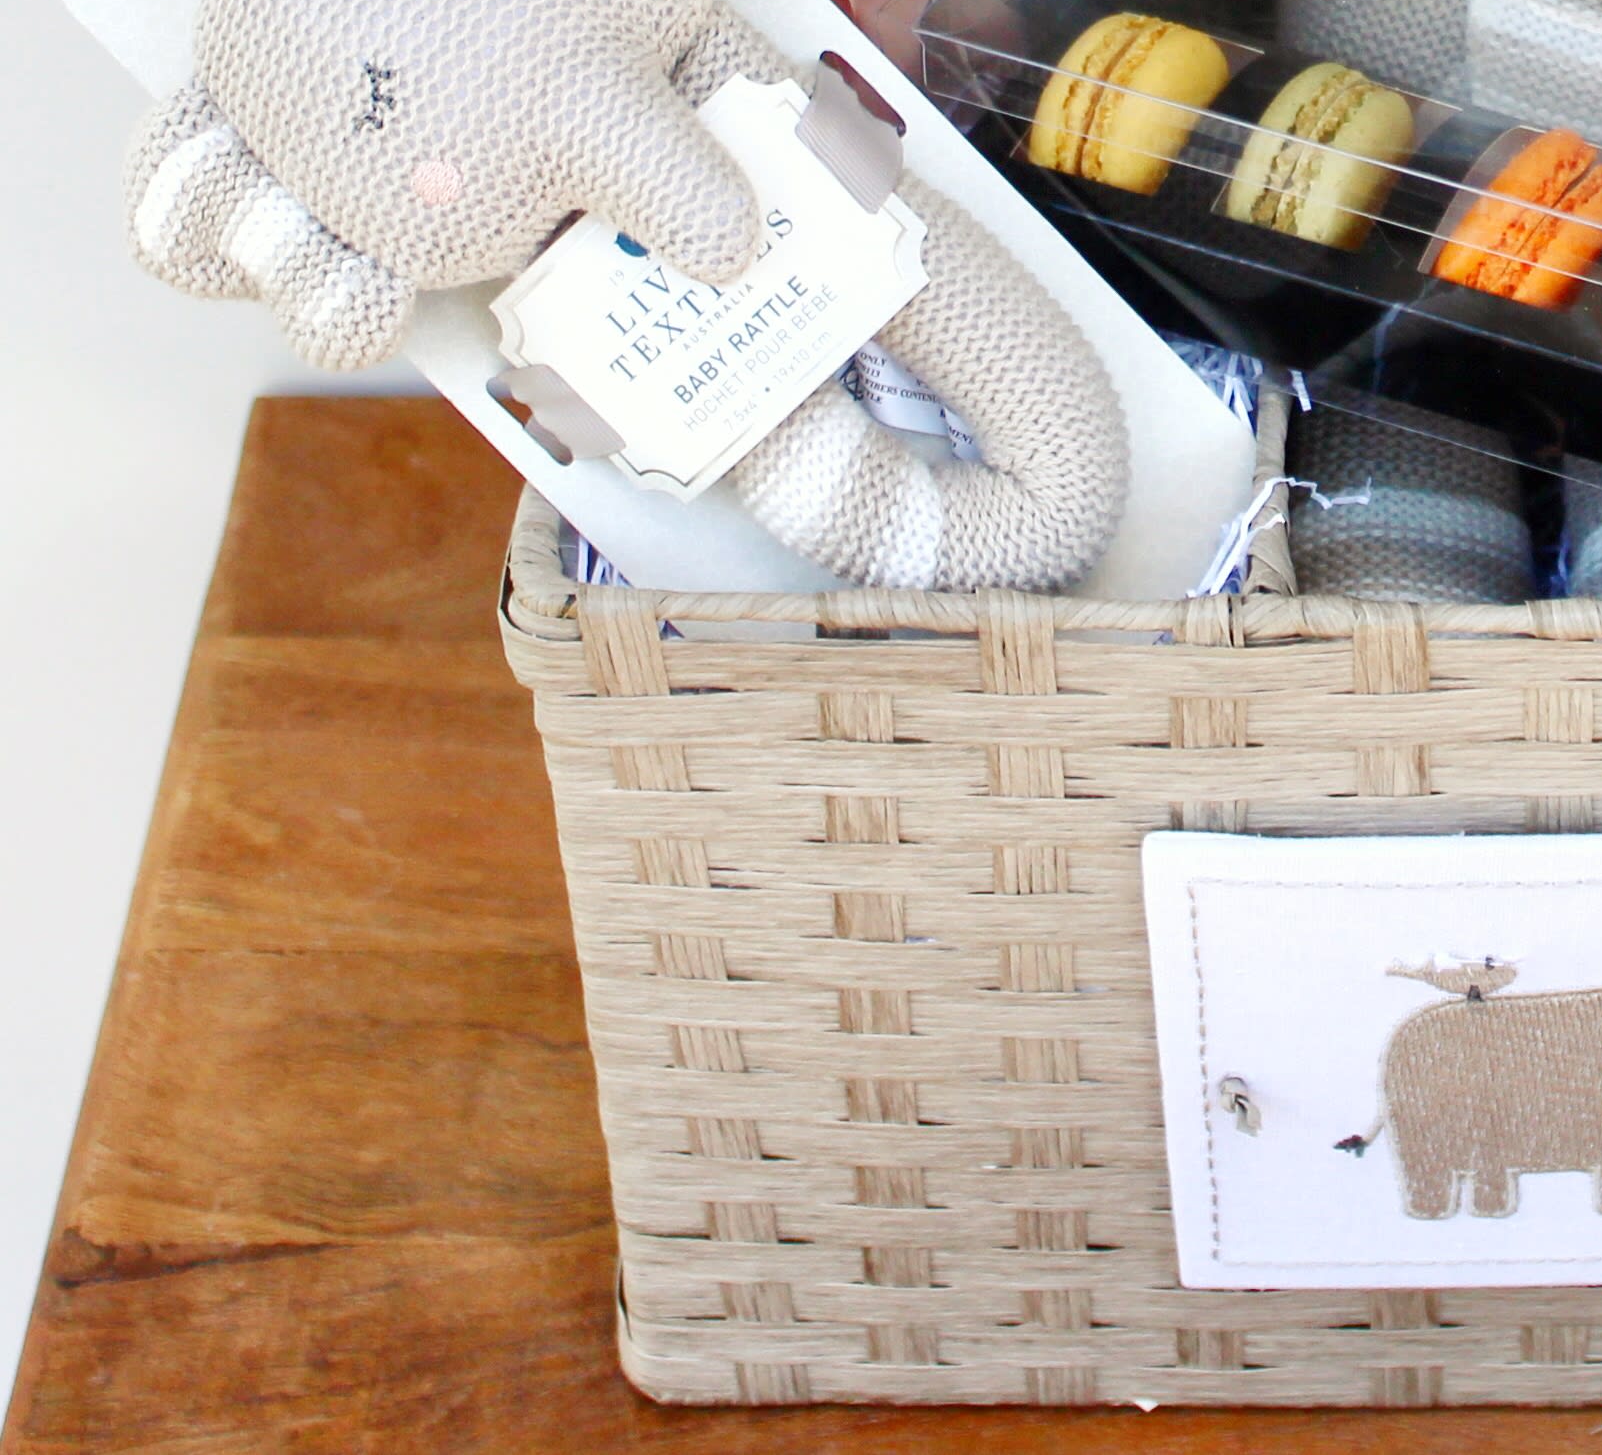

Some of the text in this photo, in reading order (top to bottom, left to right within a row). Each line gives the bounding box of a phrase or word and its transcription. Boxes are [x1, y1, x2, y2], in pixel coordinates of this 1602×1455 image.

[609, 208, 794, 383] TEXTIS
[673, 275, 809, 405] BABY RATTLE
[682, 283, 755, 351] AUSTRALIA
[683, 283, 839, 432] HOCHET POUR BÉBÉ
[860, 351, 887, 366] ONLY
